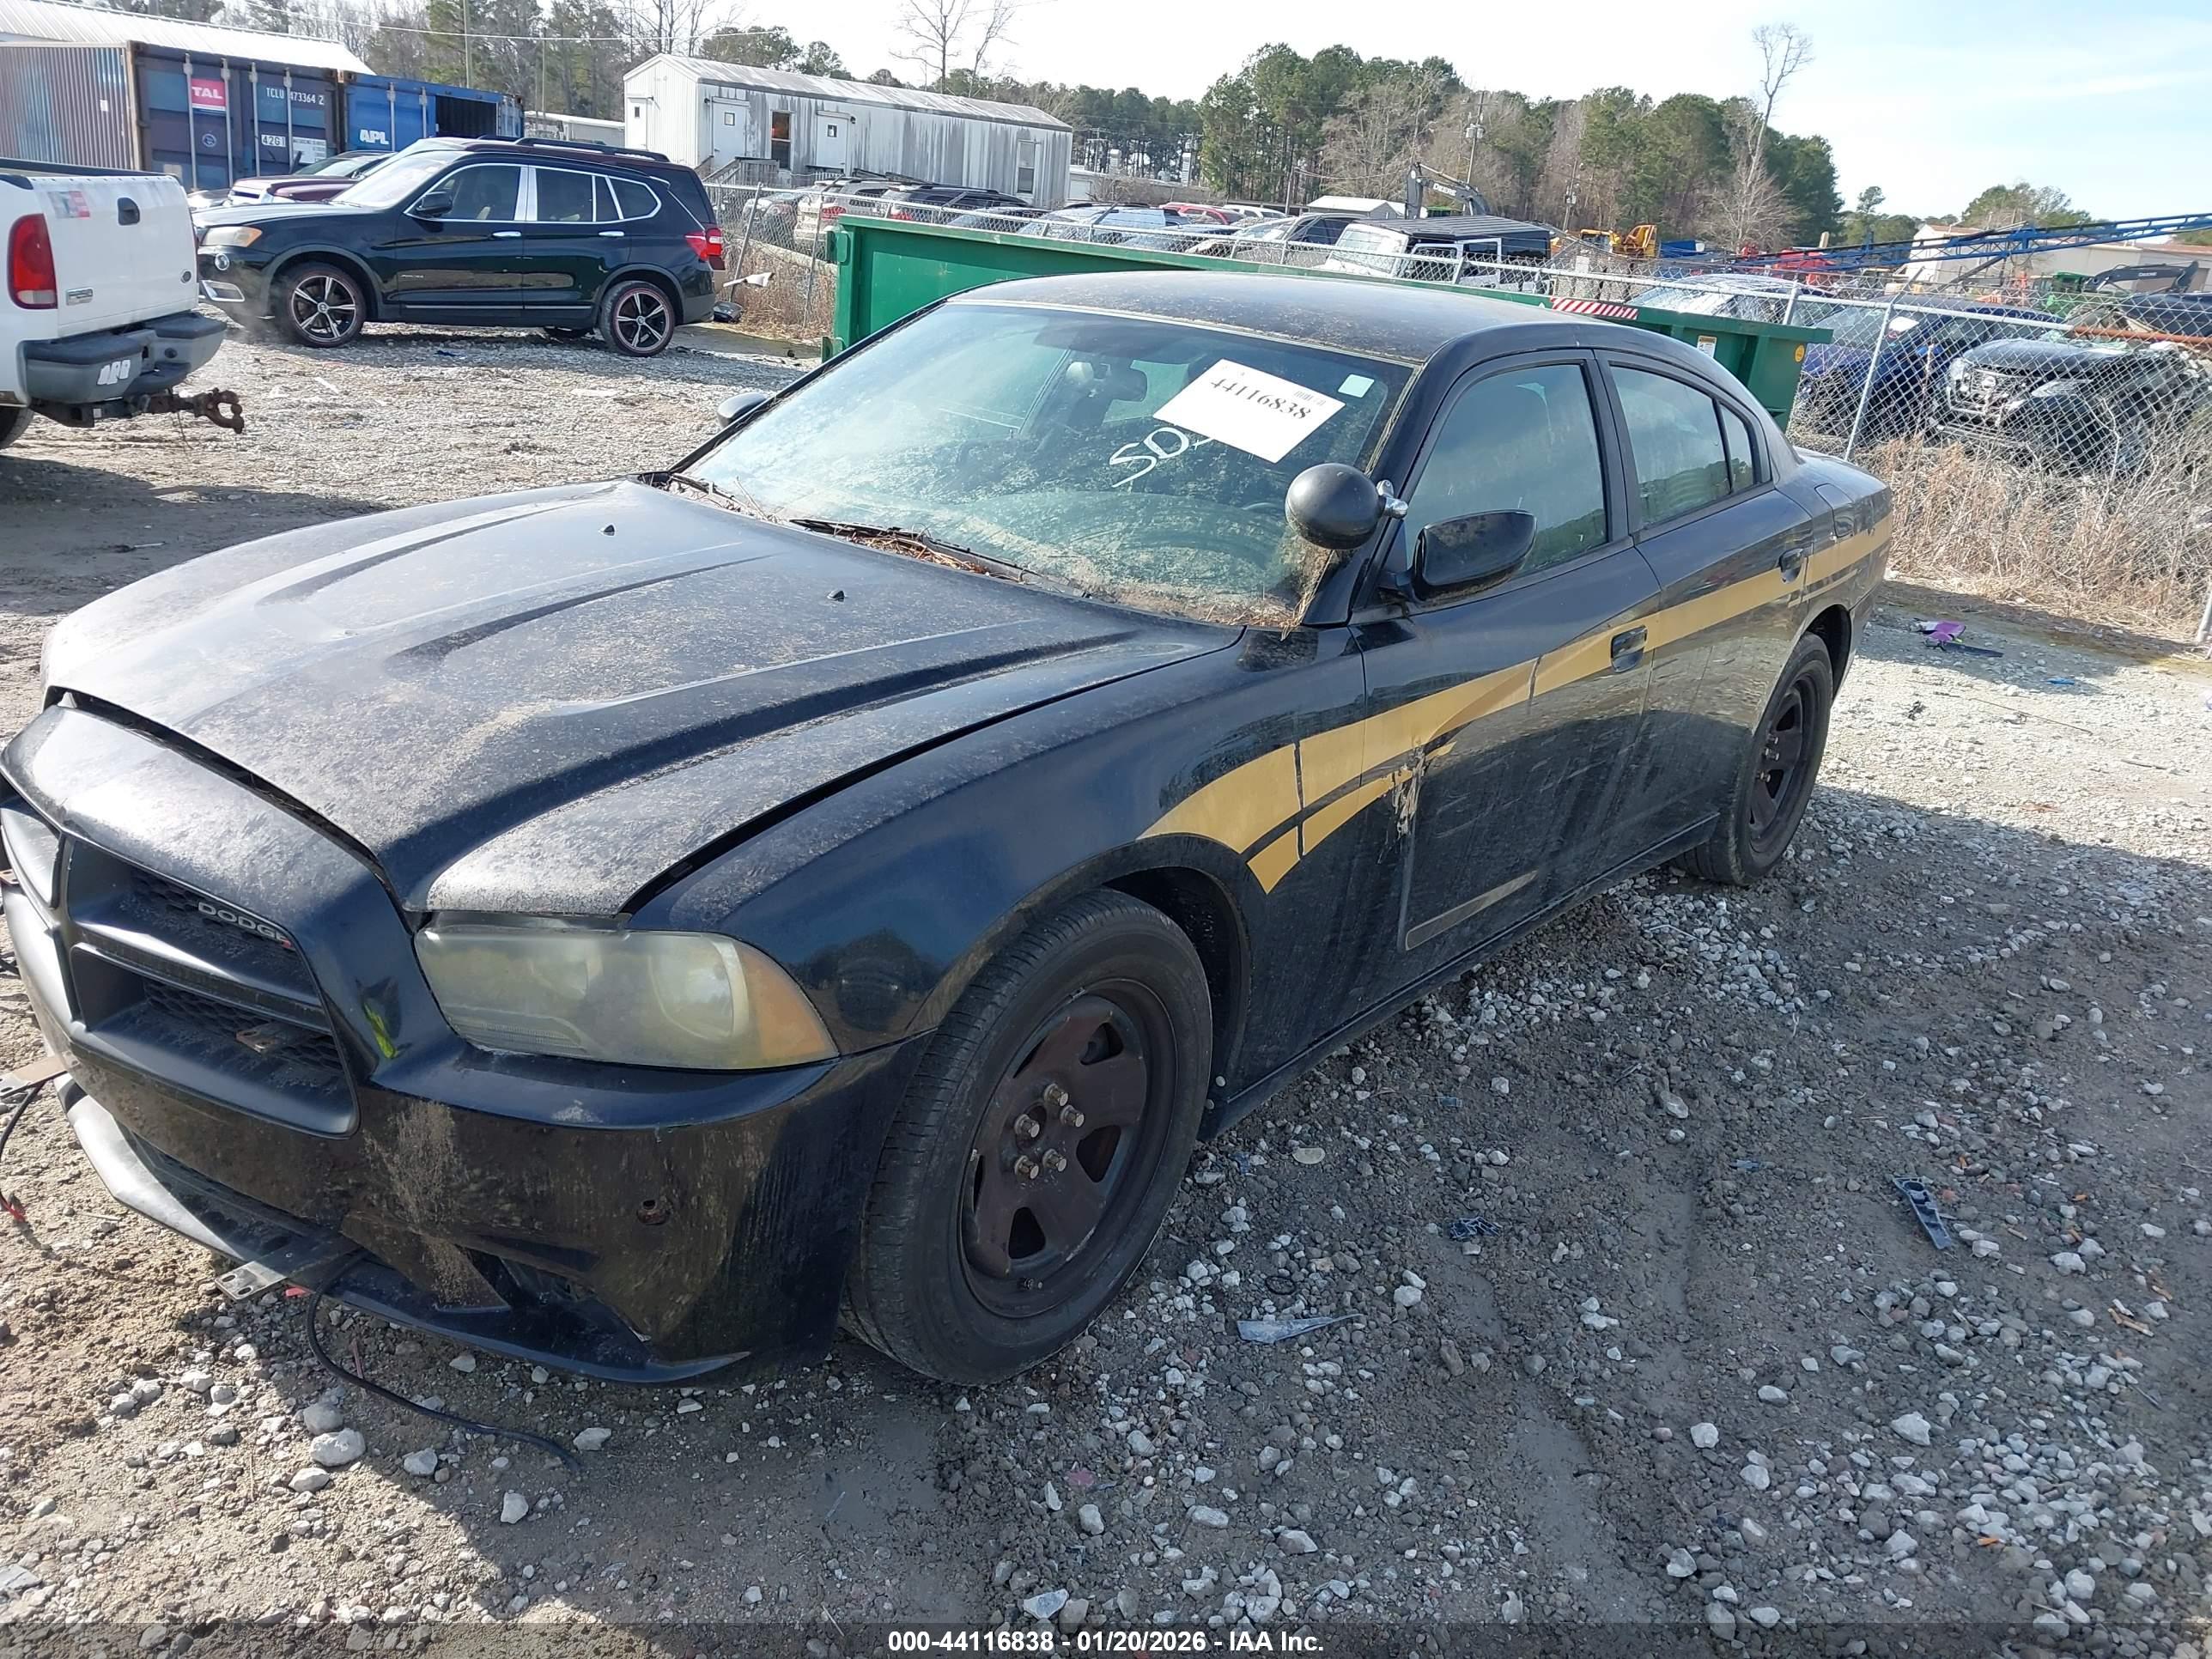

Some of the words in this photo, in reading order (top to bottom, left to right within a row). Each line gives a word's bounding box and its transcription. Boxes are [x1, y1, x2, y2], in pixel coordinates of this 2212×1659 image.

[191, 86, 224, 100] TAL
[265, 87, 285, 100] TCLU
[359, 129, 390, 145] APL
[1433, 182, 1457, 197] DEERE
[1211, 378, 1311, 419] 44116838
